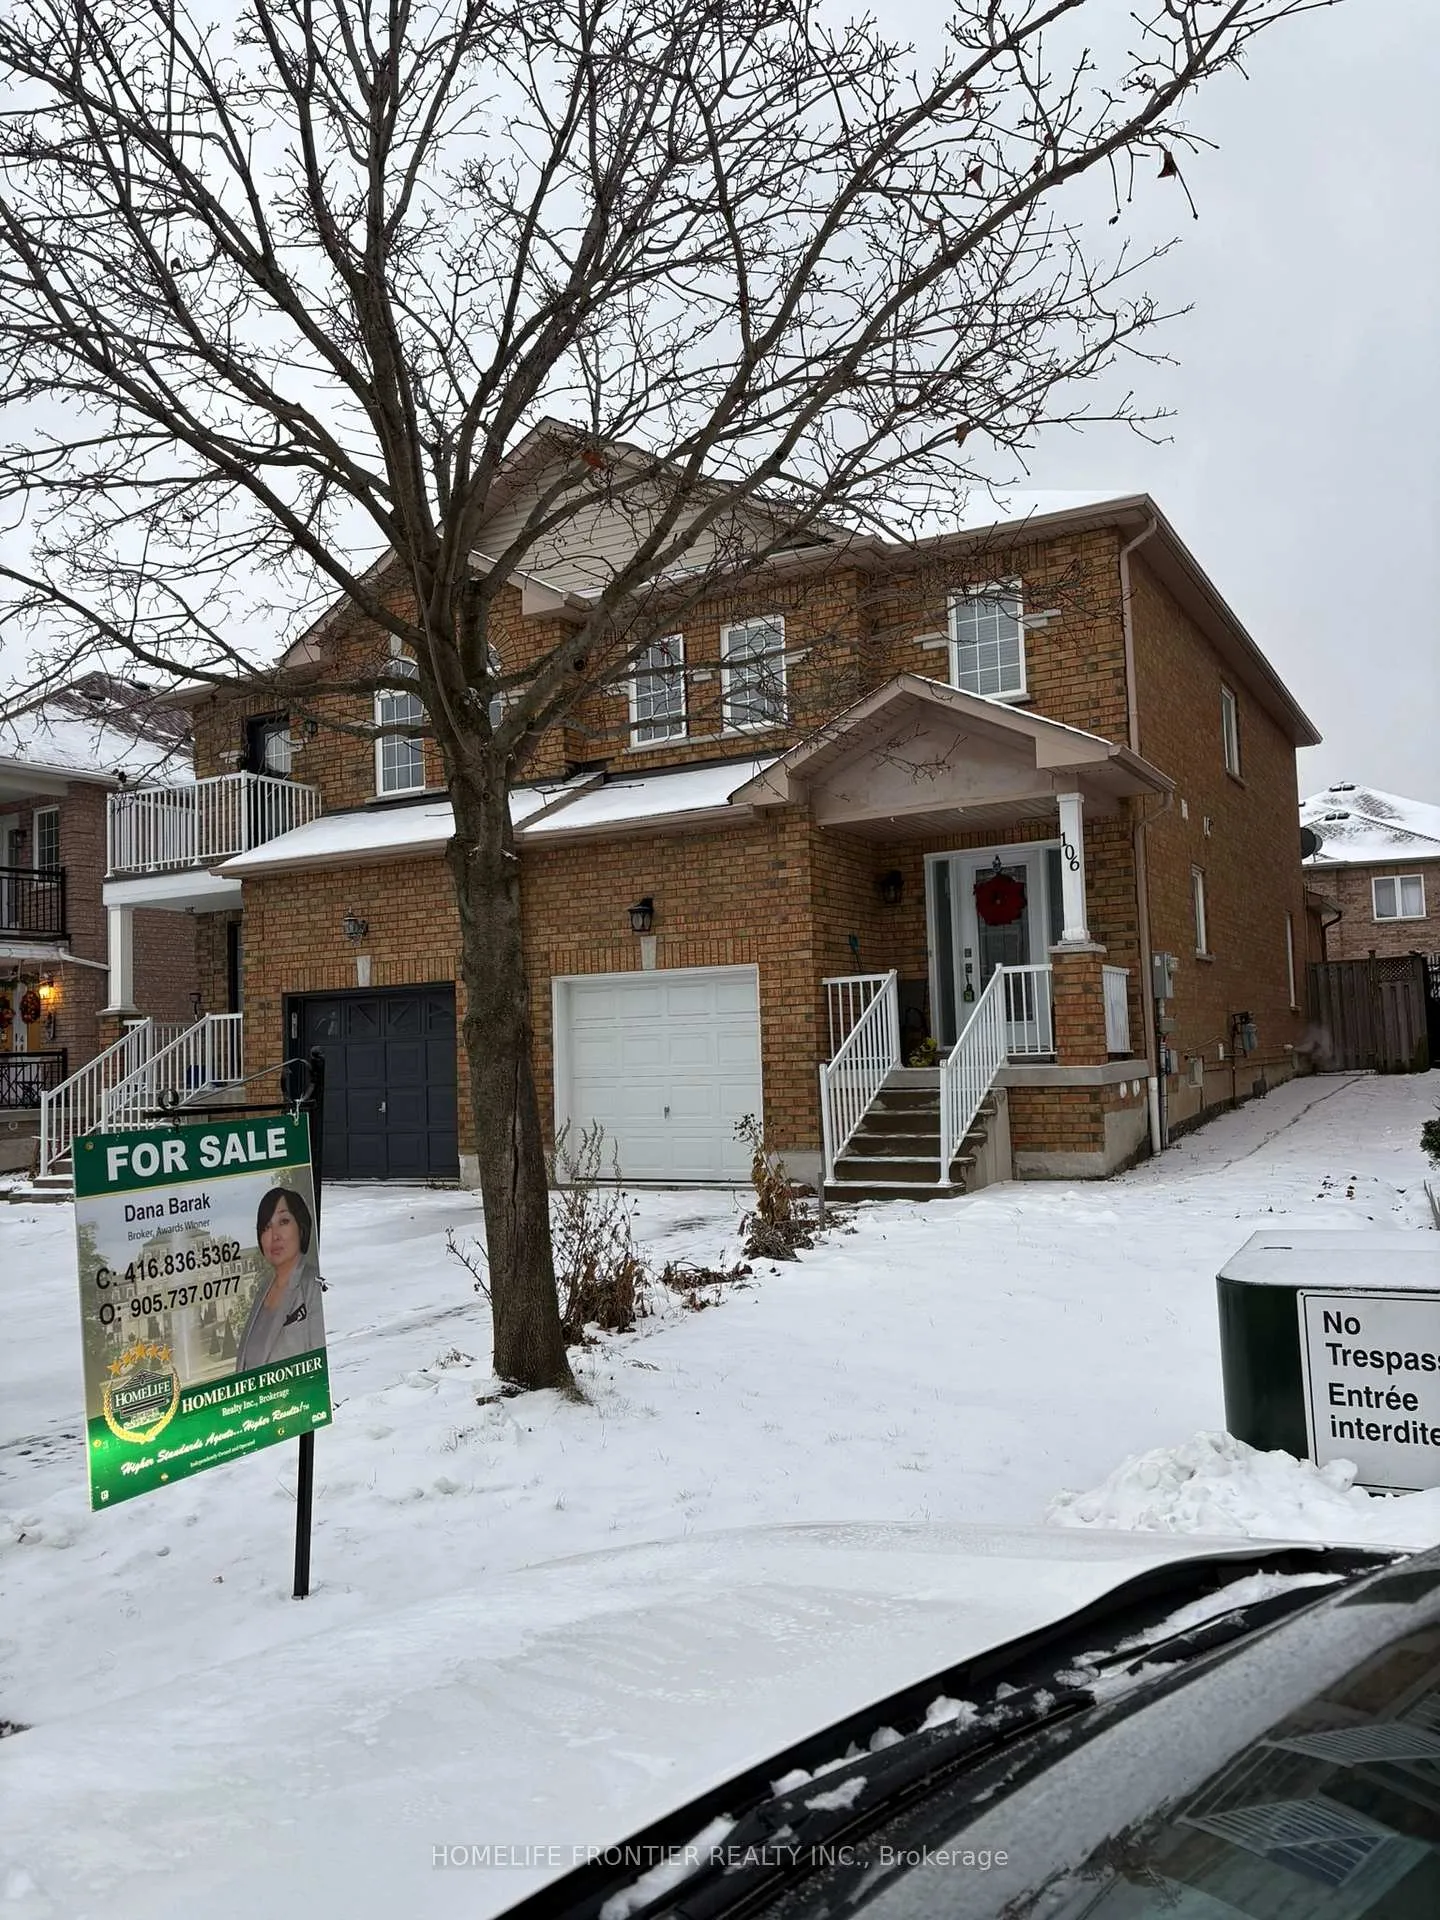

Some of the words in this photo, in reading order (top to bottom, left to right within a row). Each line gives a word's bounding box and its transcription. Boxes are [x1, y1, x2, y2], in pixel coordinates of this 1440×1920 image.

[1060, 832, 1080, 871] 106
[106, 1139, 189, 1182] FOR
[199, 1127, 288, 1168] SALE
[124, 1204, 165, 1222] Dana
[168, 1193, 211, 1215] Barak
[127, 1229, 154, 1241] Broker,
[156, 1222, 183, 1237] Awards
[184, 1219, 210, 1231] Winner
[96, 1269, 117, 1290] C:
[124, 1241, 241, 1284] 416.836.5362
[100, 1303, 121, 1325] O:
[130, 1275, 241, 1318] 905.737.0777
[1322, 1310, 1361, 1335] No
[1325, 1342, 1440, 1375] Trespas
[182, 1376, 257, 1414] HOMELIFE
[259, 1356, 323, 1388] FRONTIER
[222, 1402, 243, 1417] Realty
[259, 1388, 290, 1405] Brokerage
[1328, 1382, 1419, 1411] Entrée
[120, 1456, 154, 1476] Higher
[157, 1438, 203, 1464] Standards
